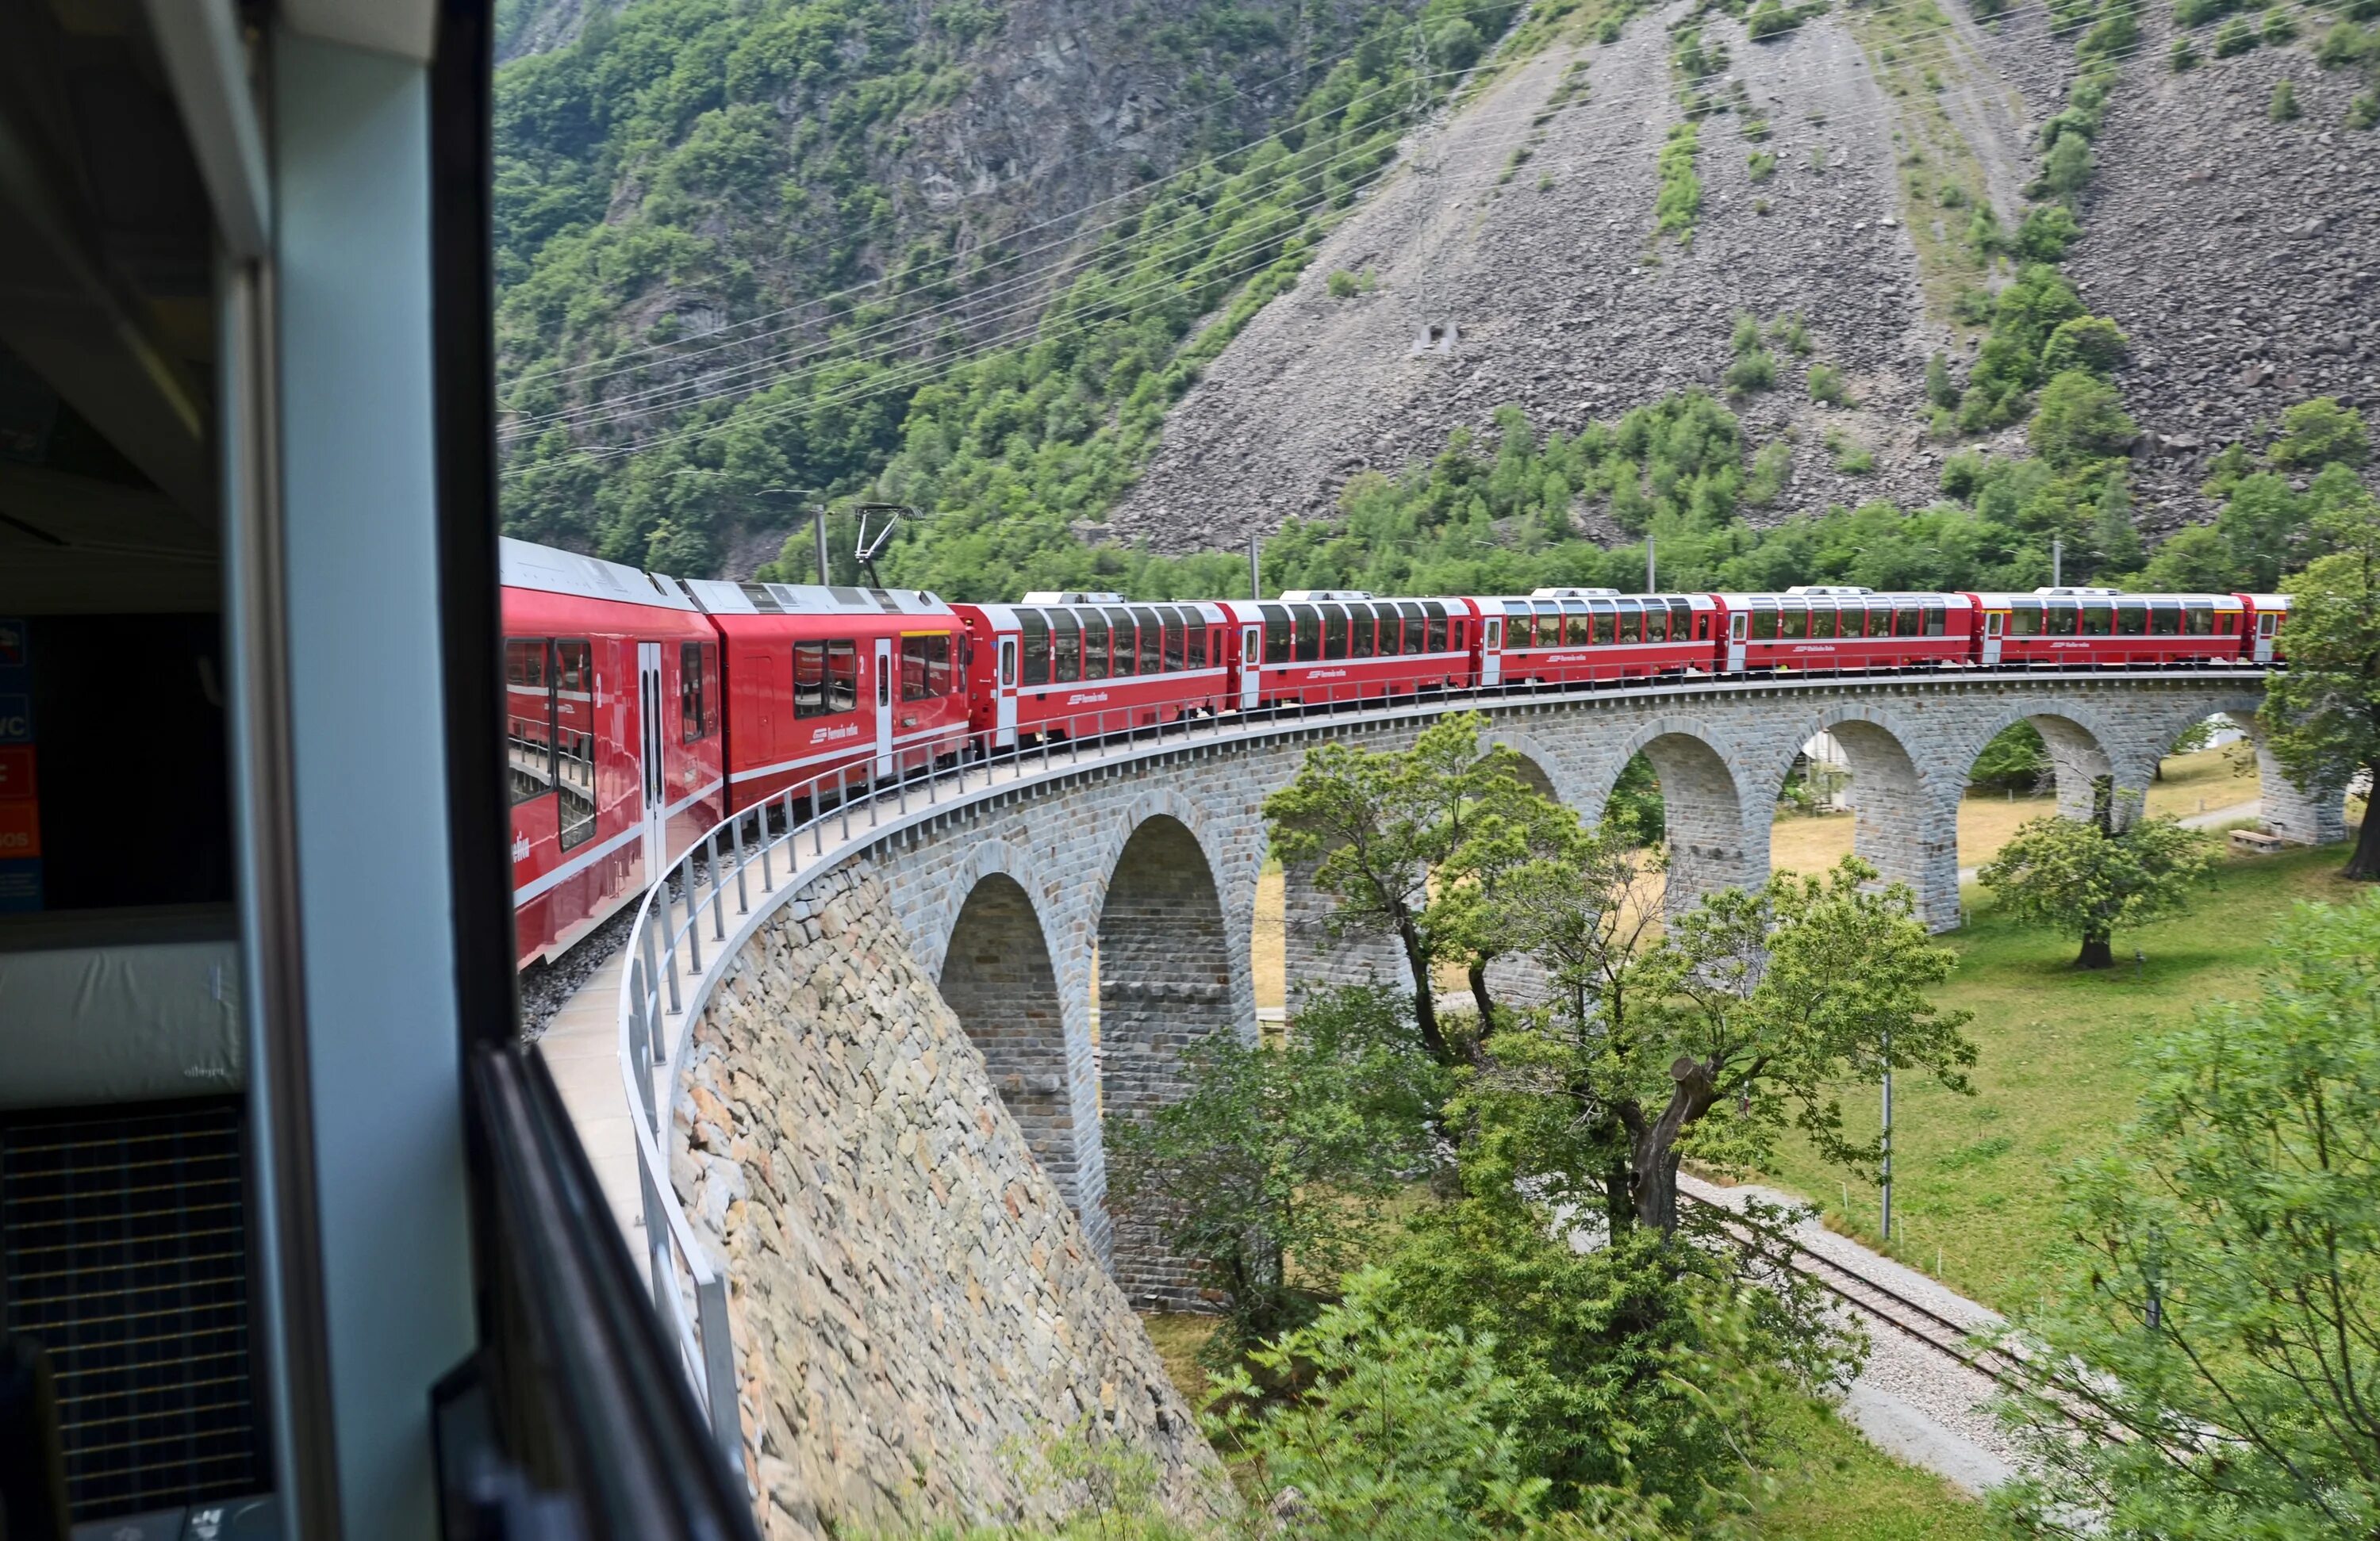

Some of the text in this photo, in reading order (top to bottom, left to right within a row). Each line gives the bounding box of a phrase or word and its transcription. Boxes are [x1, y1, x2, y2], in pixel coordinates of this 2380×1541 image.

[1290, 633, 1296, 645] 2
[1050, 646, 1055, 661] 2
[859, 655, 865, 674] 2
